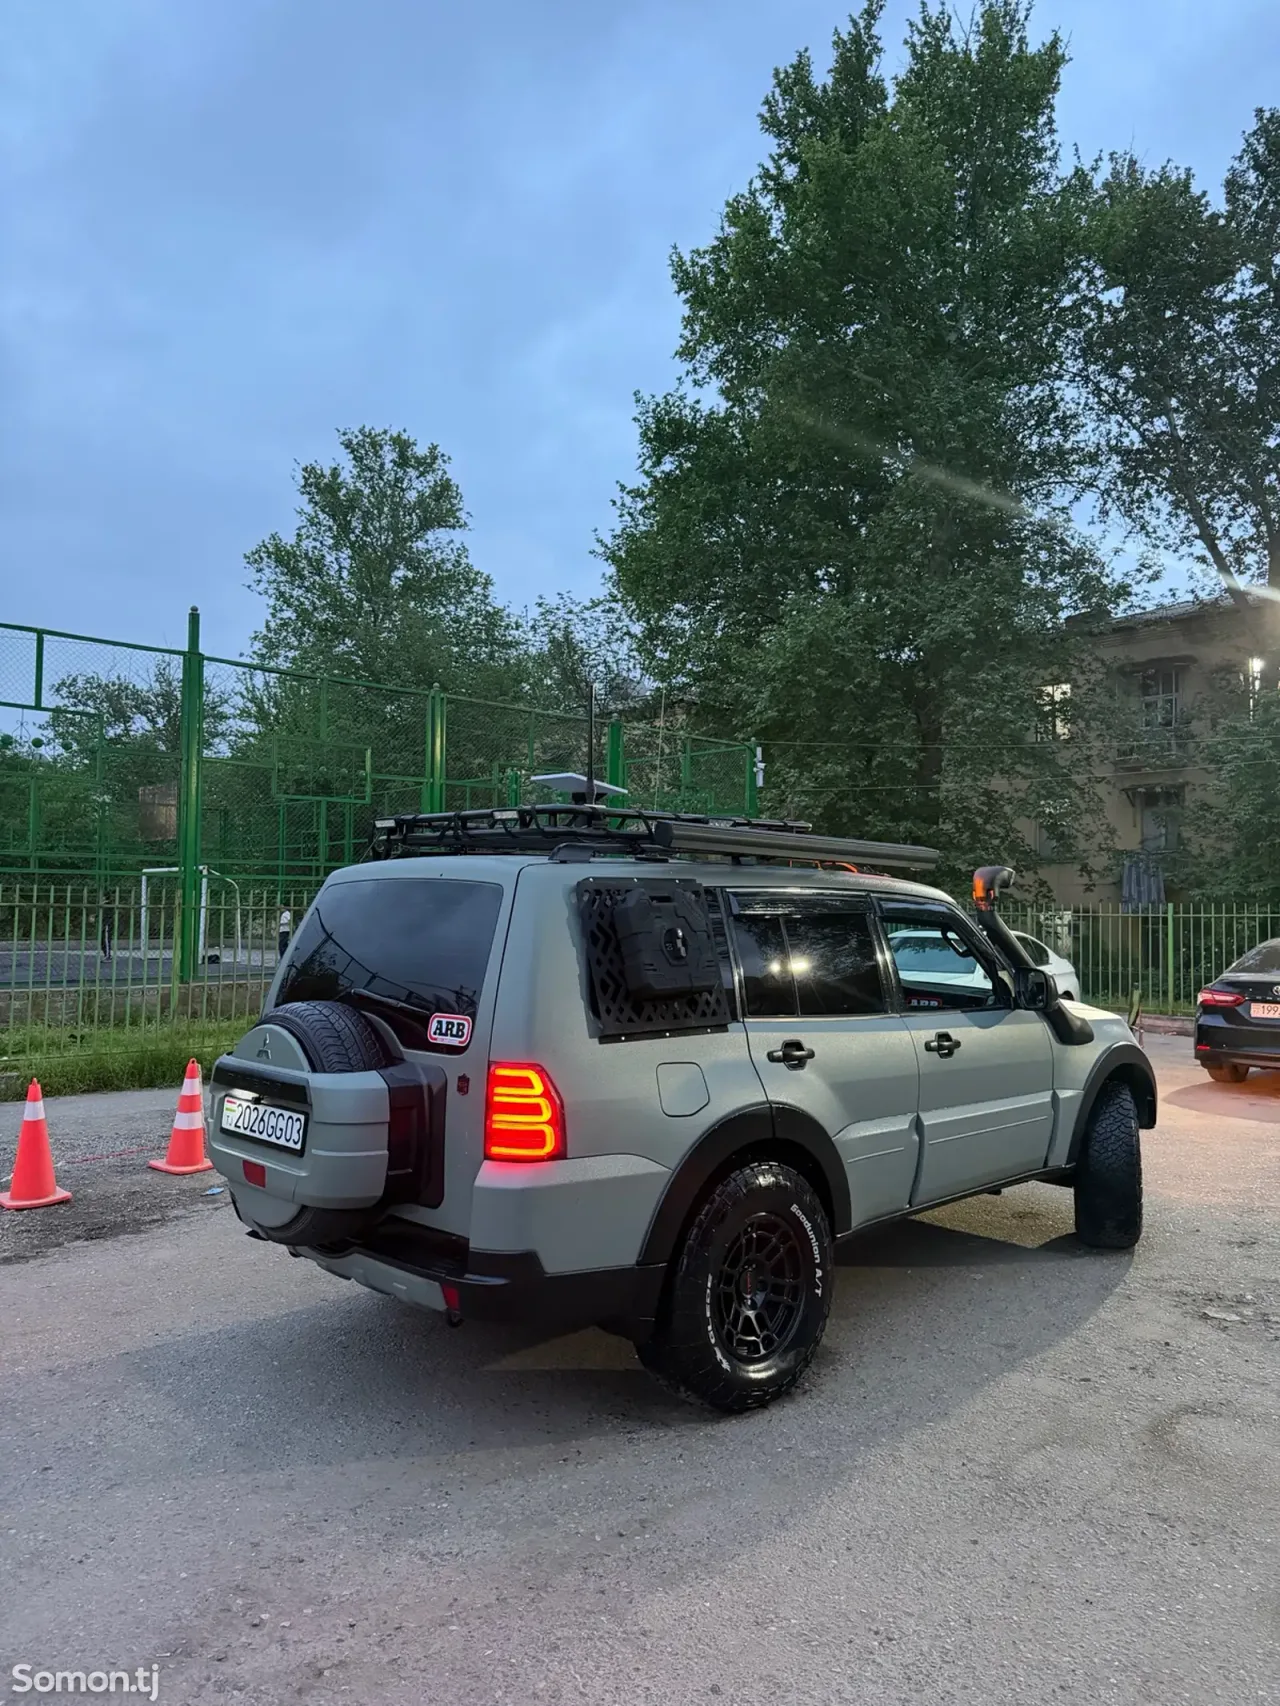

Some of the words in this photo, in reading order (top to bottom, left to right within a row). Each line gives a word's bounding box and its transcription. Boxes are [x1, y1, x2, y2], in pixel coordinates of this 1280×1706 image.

[1261, 1004, 1280, 1015] 199
[432, 1019, 466, 1039] ARB
[234, 1103, 302, 1145] 2026GG03
[790, 1203, 821, 1264] Goodunion
[815, 1268, 823, 1297] A/T
